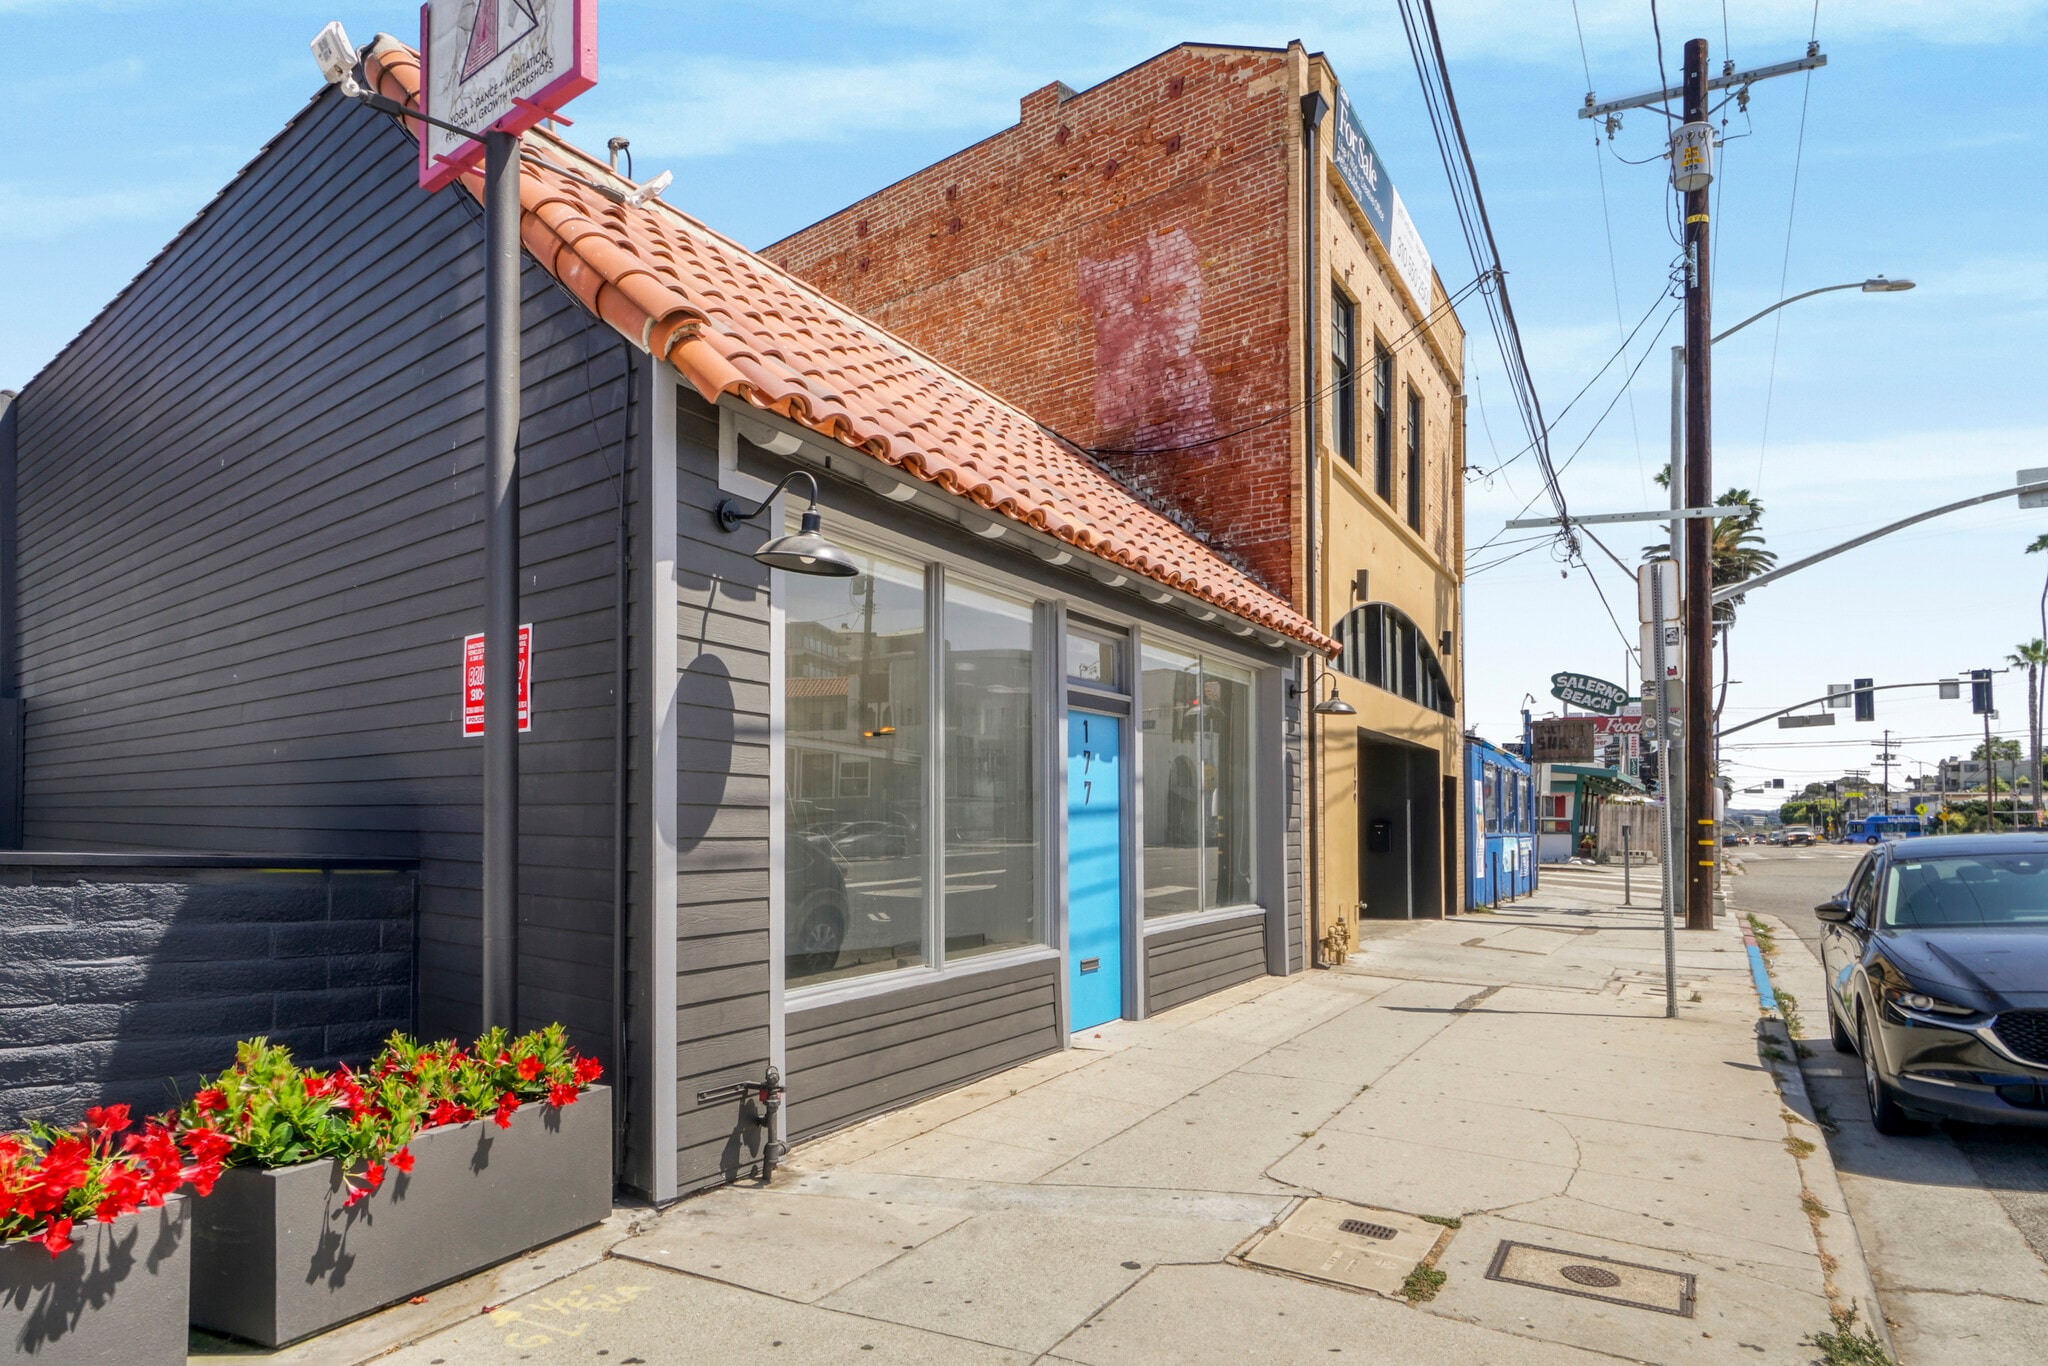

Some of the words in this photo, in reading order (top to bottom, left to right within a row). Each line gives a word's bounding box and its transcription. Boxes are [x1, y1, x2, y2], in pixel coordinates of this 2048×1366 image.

[450, 107, 468, 123] YOGA
[475, 83, 497, 108] DANCE
[505, 47, 548, 87] MEDITATION
[478, 90, 507, 119] GROWTH
[508, 57, 554, 96] WORKSHOPS
[1339, 100, 1358, 155] For
[1358, 137, 1377, 192] Sale
[1556, 676, 1626, 703] SALERNO
[1560, 688, 1612, 711] BEACH
[1601, 717, 1643, 733] Food
[1082, 719, 1092, 807] 177
